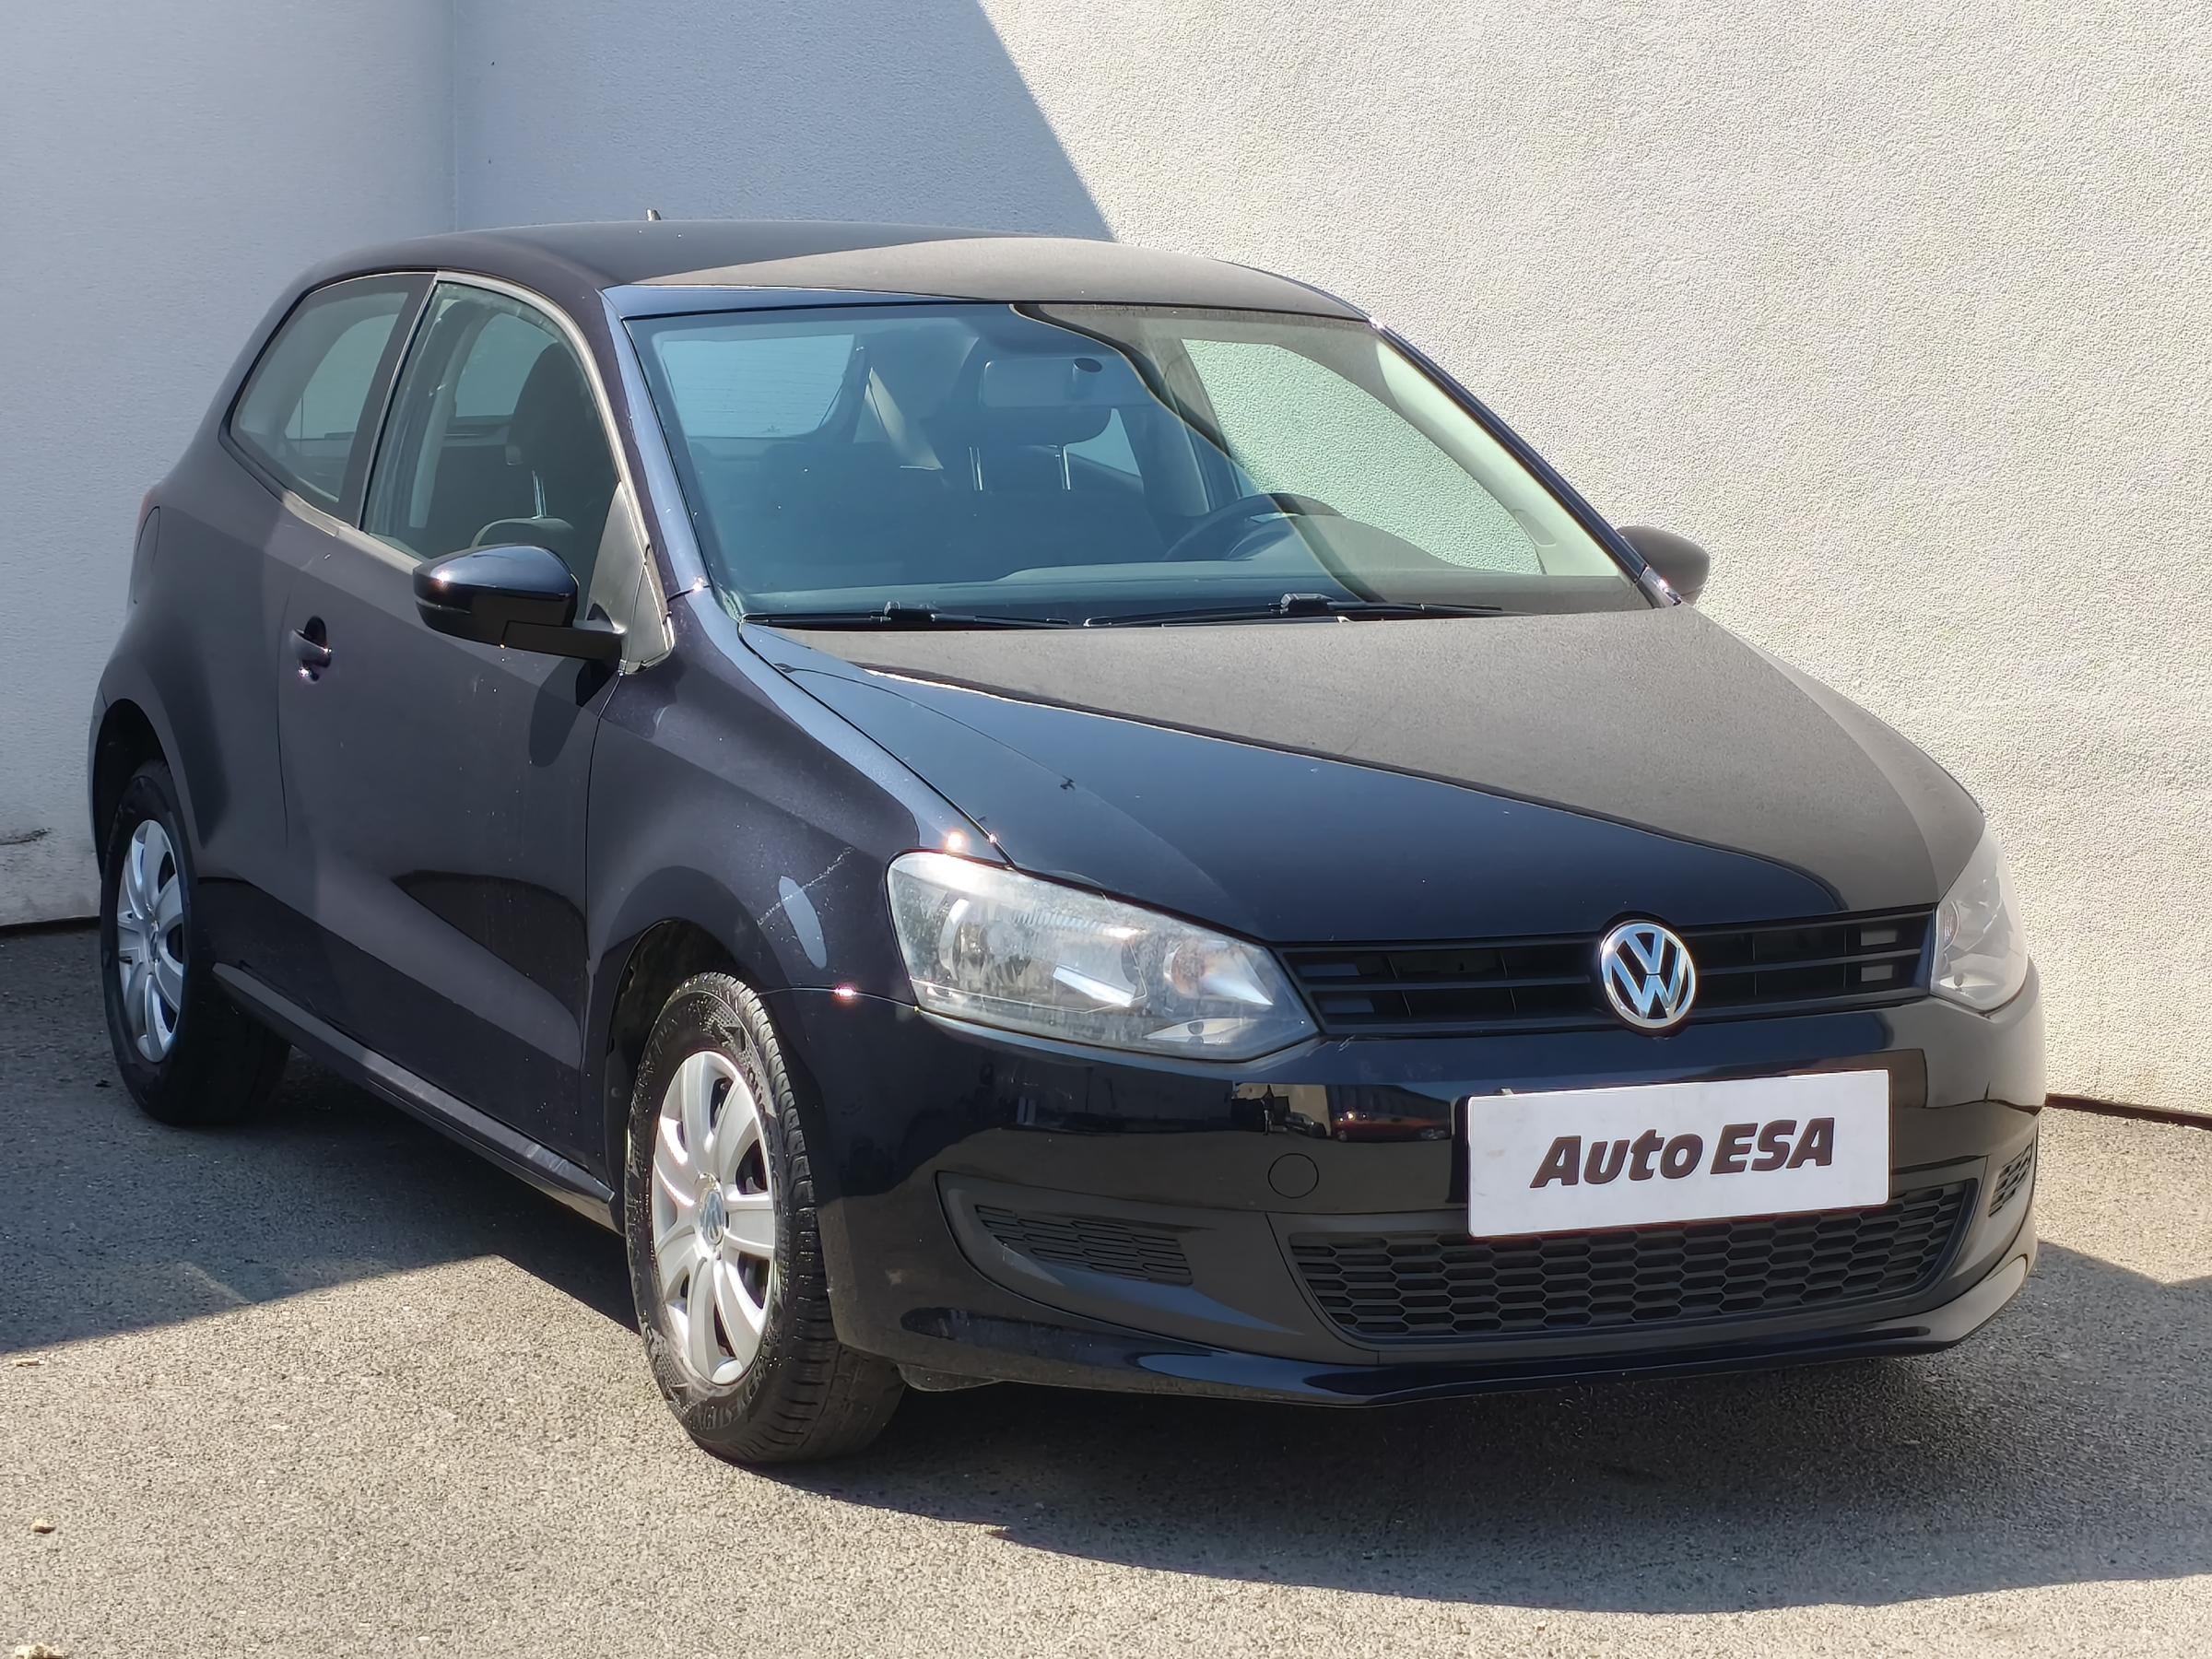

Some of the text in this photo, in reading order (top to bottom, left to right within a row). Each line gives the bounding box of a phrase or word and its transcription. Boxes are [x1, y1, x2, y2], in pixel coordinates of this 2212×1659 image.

[1602, 923, 1694, 1026] VW
[1530, 1117, 1835, 1189] Auto ESA
